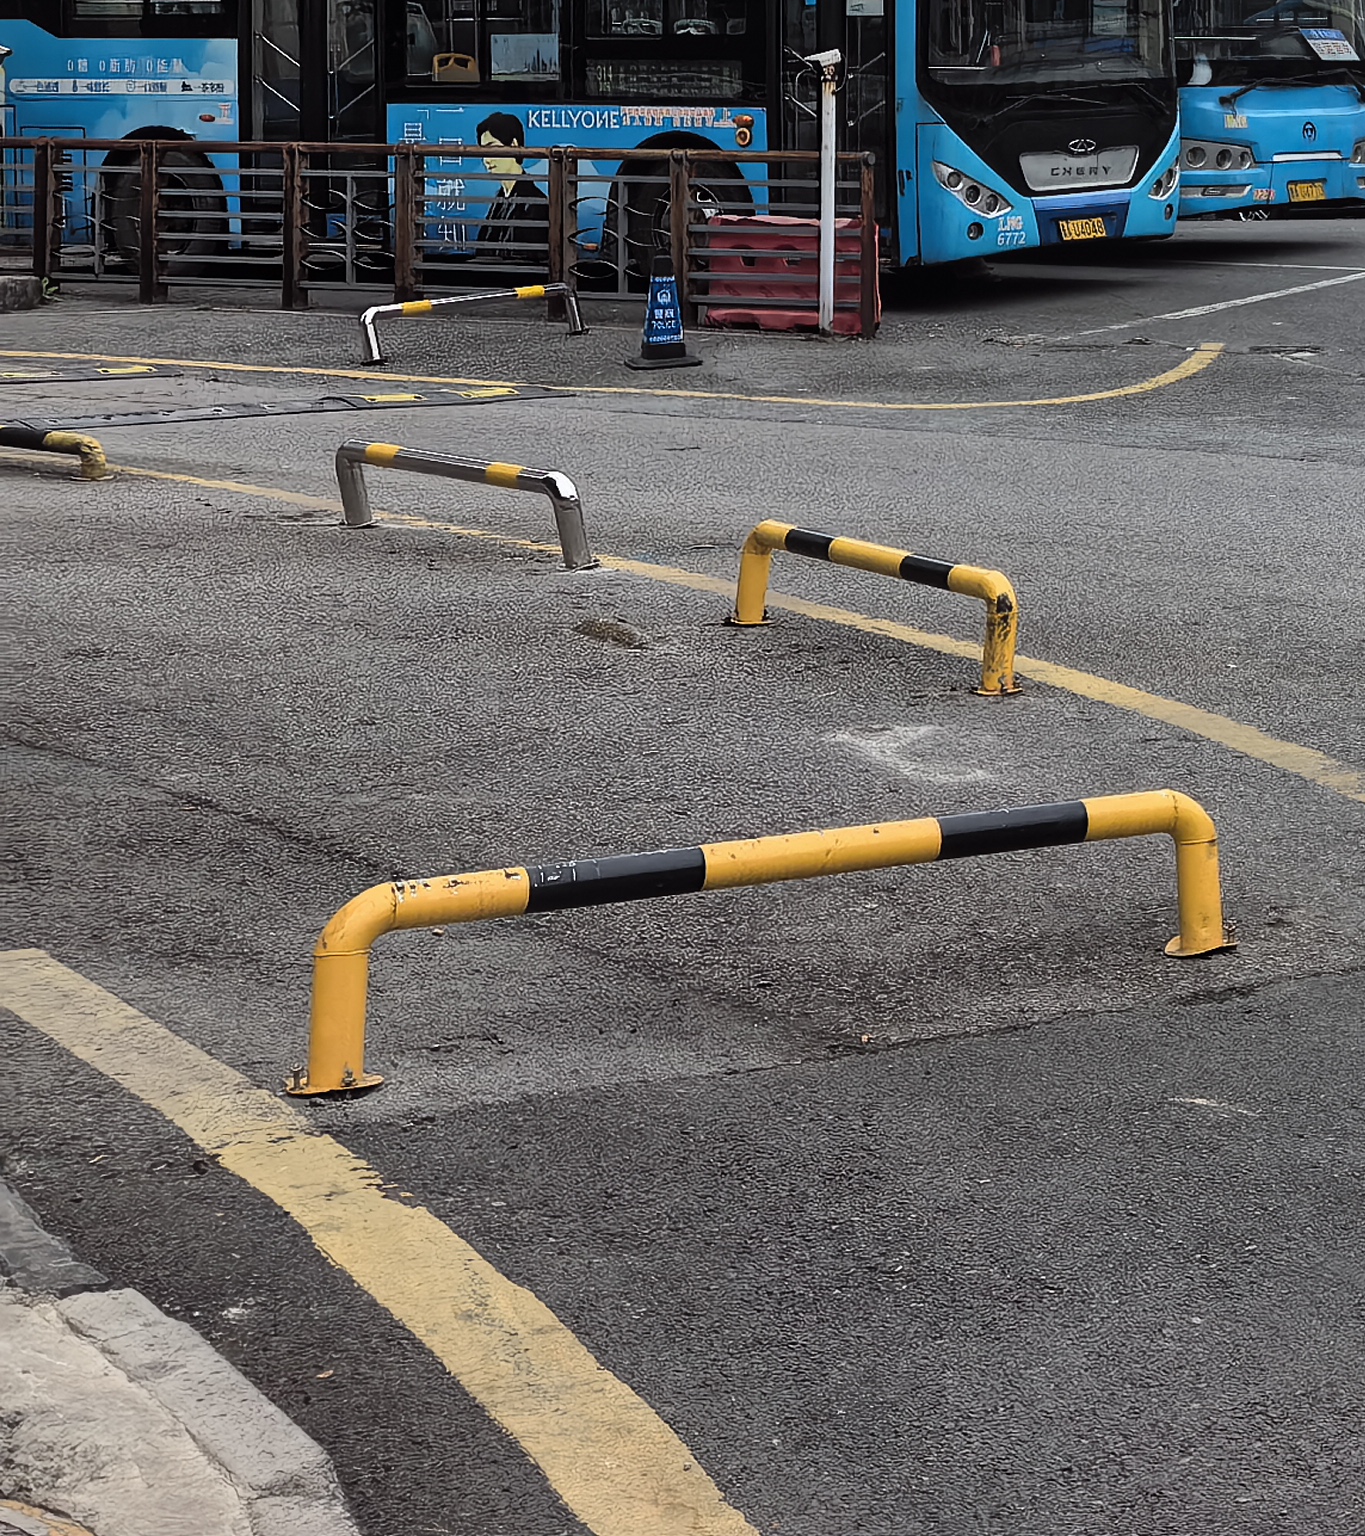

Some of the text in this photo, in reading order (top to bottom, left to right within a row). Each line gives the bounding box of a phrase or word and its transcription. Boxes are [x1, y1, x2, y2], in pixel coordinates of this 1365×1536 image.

[528, 109, 620, 129] KELLYONE
[1050, 166, 1112, 177] CHERY
[997, 232, 1026, 246] 6772
